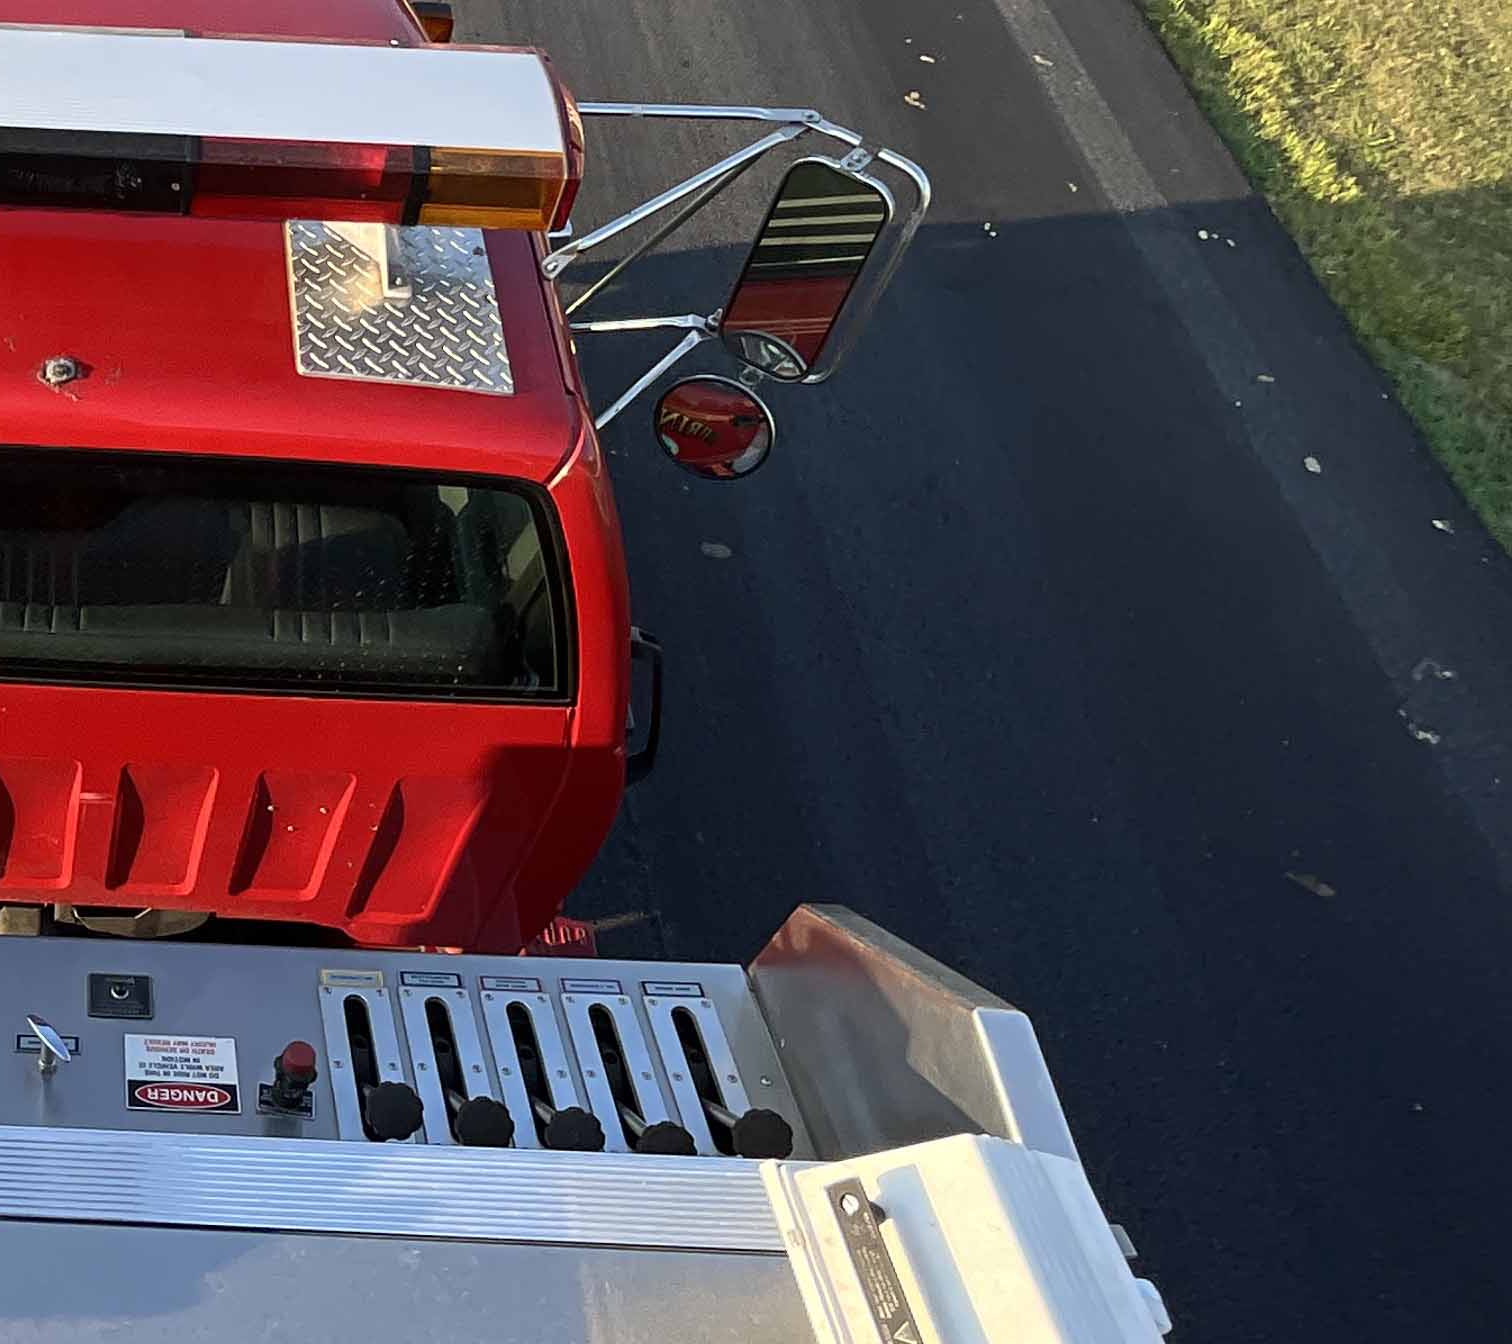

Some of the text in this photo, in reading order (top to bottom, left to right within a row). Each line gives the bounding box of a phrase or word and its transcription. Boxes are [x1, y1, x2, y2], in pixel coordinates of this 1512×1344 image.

[148, 1062, 179, 1070] VEHICLE
[193, 1071, 208, 1079] NOT
[147, 1087, 219, 1103] DANGER
